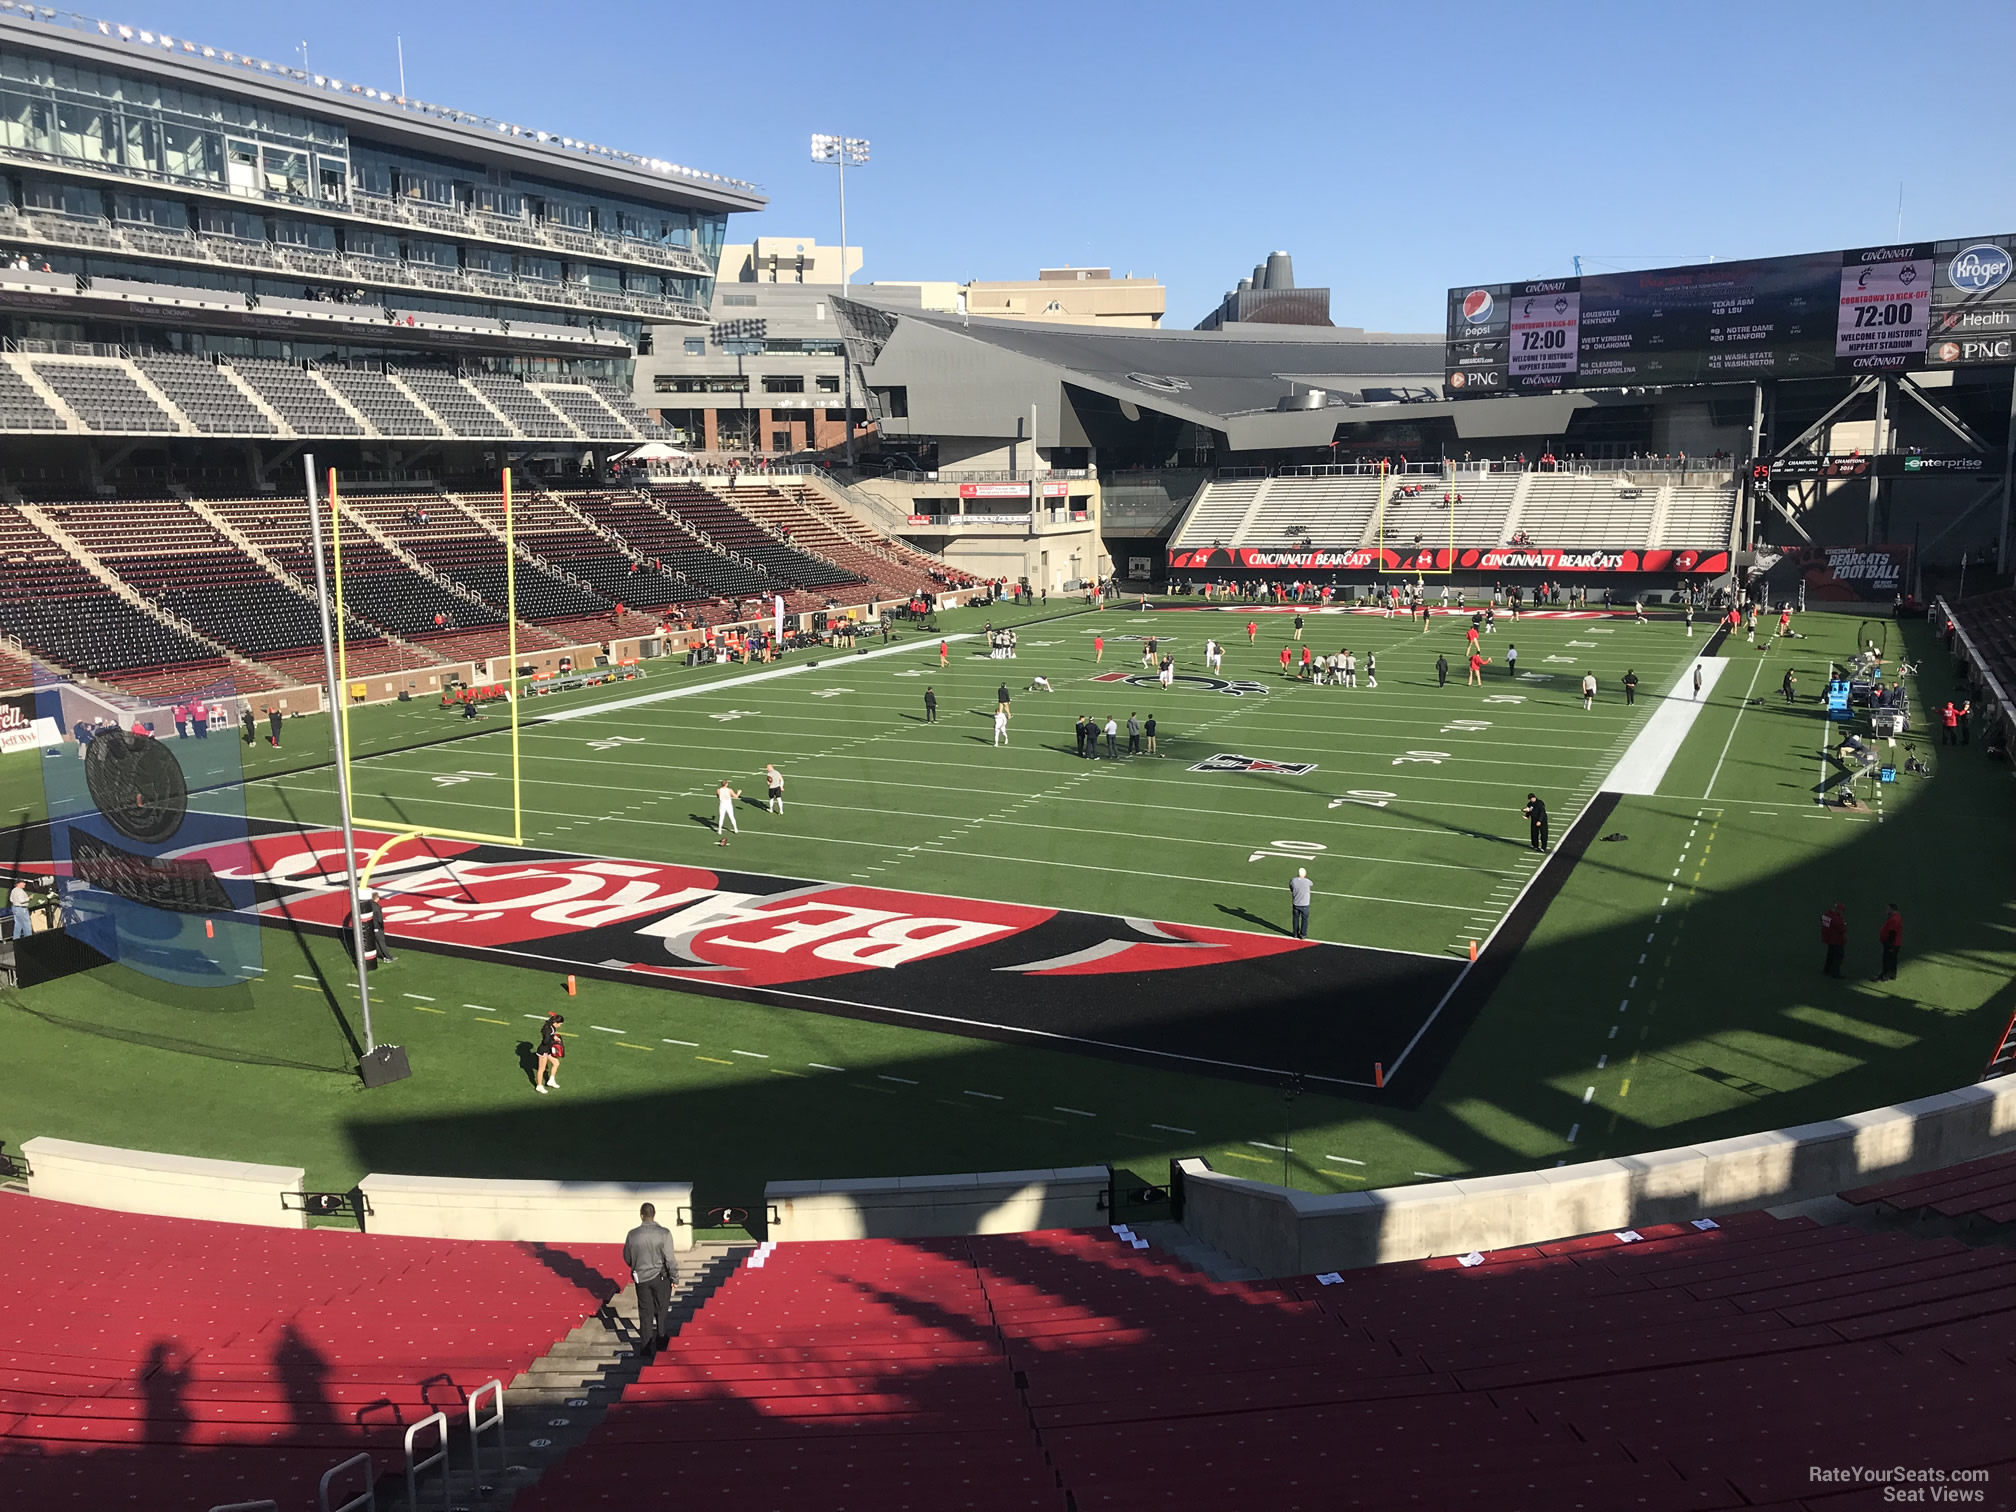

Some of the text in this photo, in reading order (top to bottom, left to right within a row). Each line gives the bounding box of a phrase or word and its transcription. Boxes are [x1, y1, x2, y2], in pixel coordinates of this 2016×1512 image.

[1861, 248, 1914, 261] CINCINNATI
[1957, 254, 2006, 286] Kroger
[1526, 282, 1566, 293] CINCINNATI
[1737, 298, 1754, 306] A&M
[1841, 294, 1884, 304] COUNTDOWN
[1896, 291, 1928, 300] KICK-OFF
[1583, 310, 1620, 318] LOUISVILLE
[1855, 303, 1912, 327] 72:00
[1963, 311, 2009, 326] Health
[1512, 322, 1544, 330] COUNTDOWN
[1583, 317, 1616, 325] KENTUCKY
[1466, 326, 1490, 336] pepsi
[1728, 332, 1766, 340] STANFORD
[1841, 329, 1922, 341] WELCOME TO HISTORIC
[1522, 330, 1565, 350] 72:00
[1601, 334, 1632, 342] VIRGINIA
[1594, 342, 1630, 350] OKLAHOMA
[1849, 340, 1912, 351] NIPPERT STADIUM
[1963, 342, 2009, 358] PNC
[1512, 354, 1538, 362] WELCOME
[1548, 352, 1573, 360] HISTORIC
[1724, 359, 1774, 367] WASHINGTON
[1853, 355, 1905, 367] CINCINNATI
[1542, 362, 1566, 370] STADIUM
[1468, 372, 1498, 385] PNC
[1522, 376, 1561, 385] CINCINNATI
[1905, 458, 1982, 468] enterprise
[1753, 465, 1768, 477] 25
[1249, 551, 1371, 566] CINCINNATI BEARCATS
[1481, 551, 1623, 567] CINCINNATI BEARCATS
[1828, 553, 1890, 566] BEARCATS
[1832, 565, 1900, 579] FOOTBALL
[1440, 720, 1493, 732] 40
[1, 736, 17, 748] Jeff
[1392, 751, 1451, 765] 30
[1328, 790, 1397, 808] 20
[1248, 840, 1327, 862] 10
[213, 848, 1019, 968] BEARCATS
